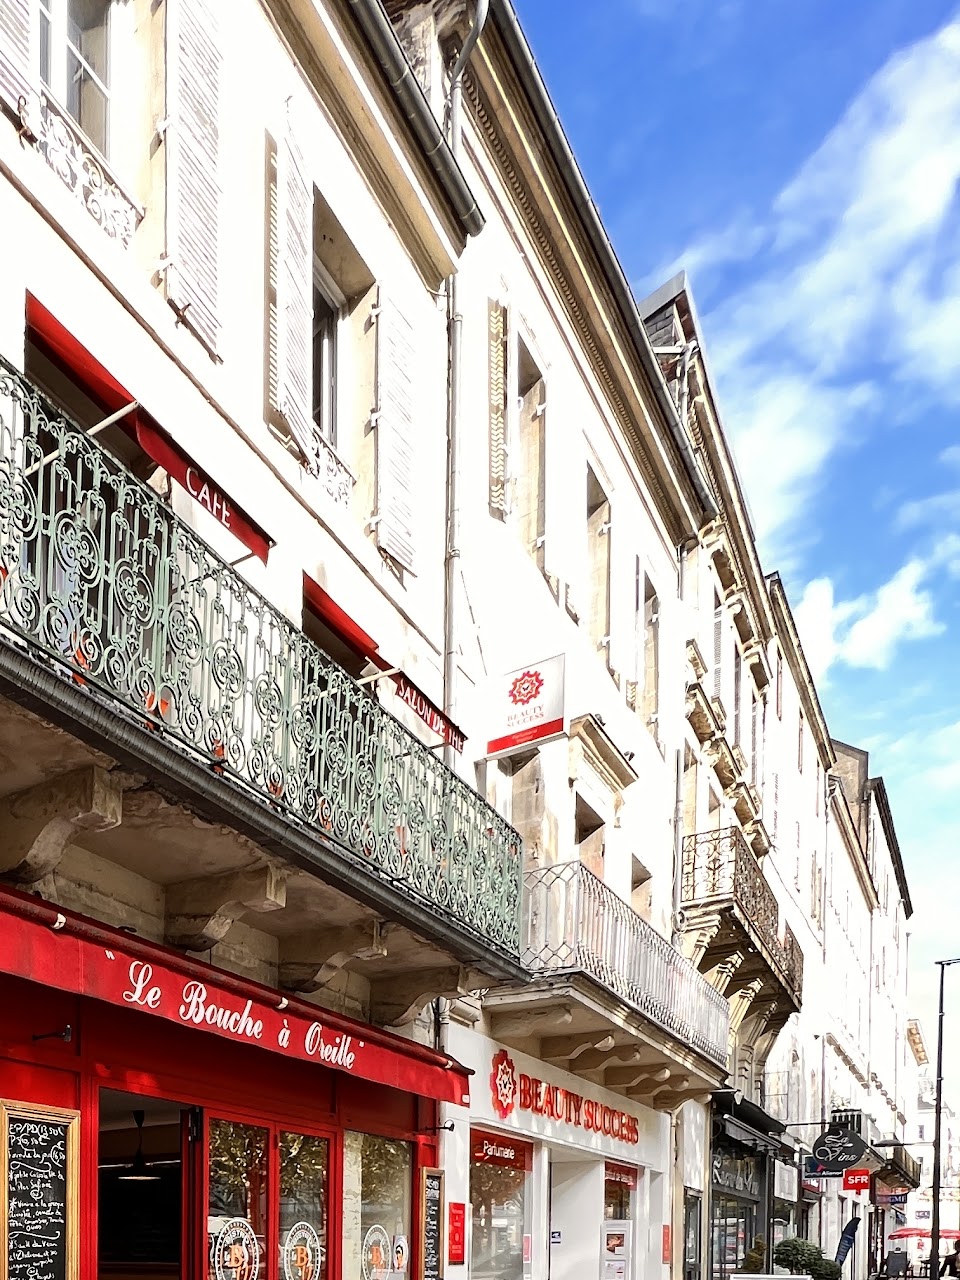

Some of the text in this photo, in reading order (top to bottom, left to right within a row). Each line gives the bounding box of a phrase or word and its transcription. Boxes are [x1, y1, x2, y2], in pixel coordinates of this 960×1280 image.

[399, 678, 432, 724] SALON
[432, 713, 446, 737] DE
[507, 704, 544, 722] BEAUTY
[507, 712, 544, 727] SUCCESS
[179, 981, 263, 1039] Bouche
[278, 1019, 290, 1048] à
[519, 1074, 639, 1146] BEAUTY SUCCESS
[483, 1140, 515, 1160] Parfumerie
[847, 1175, 868, 1184] SFR
